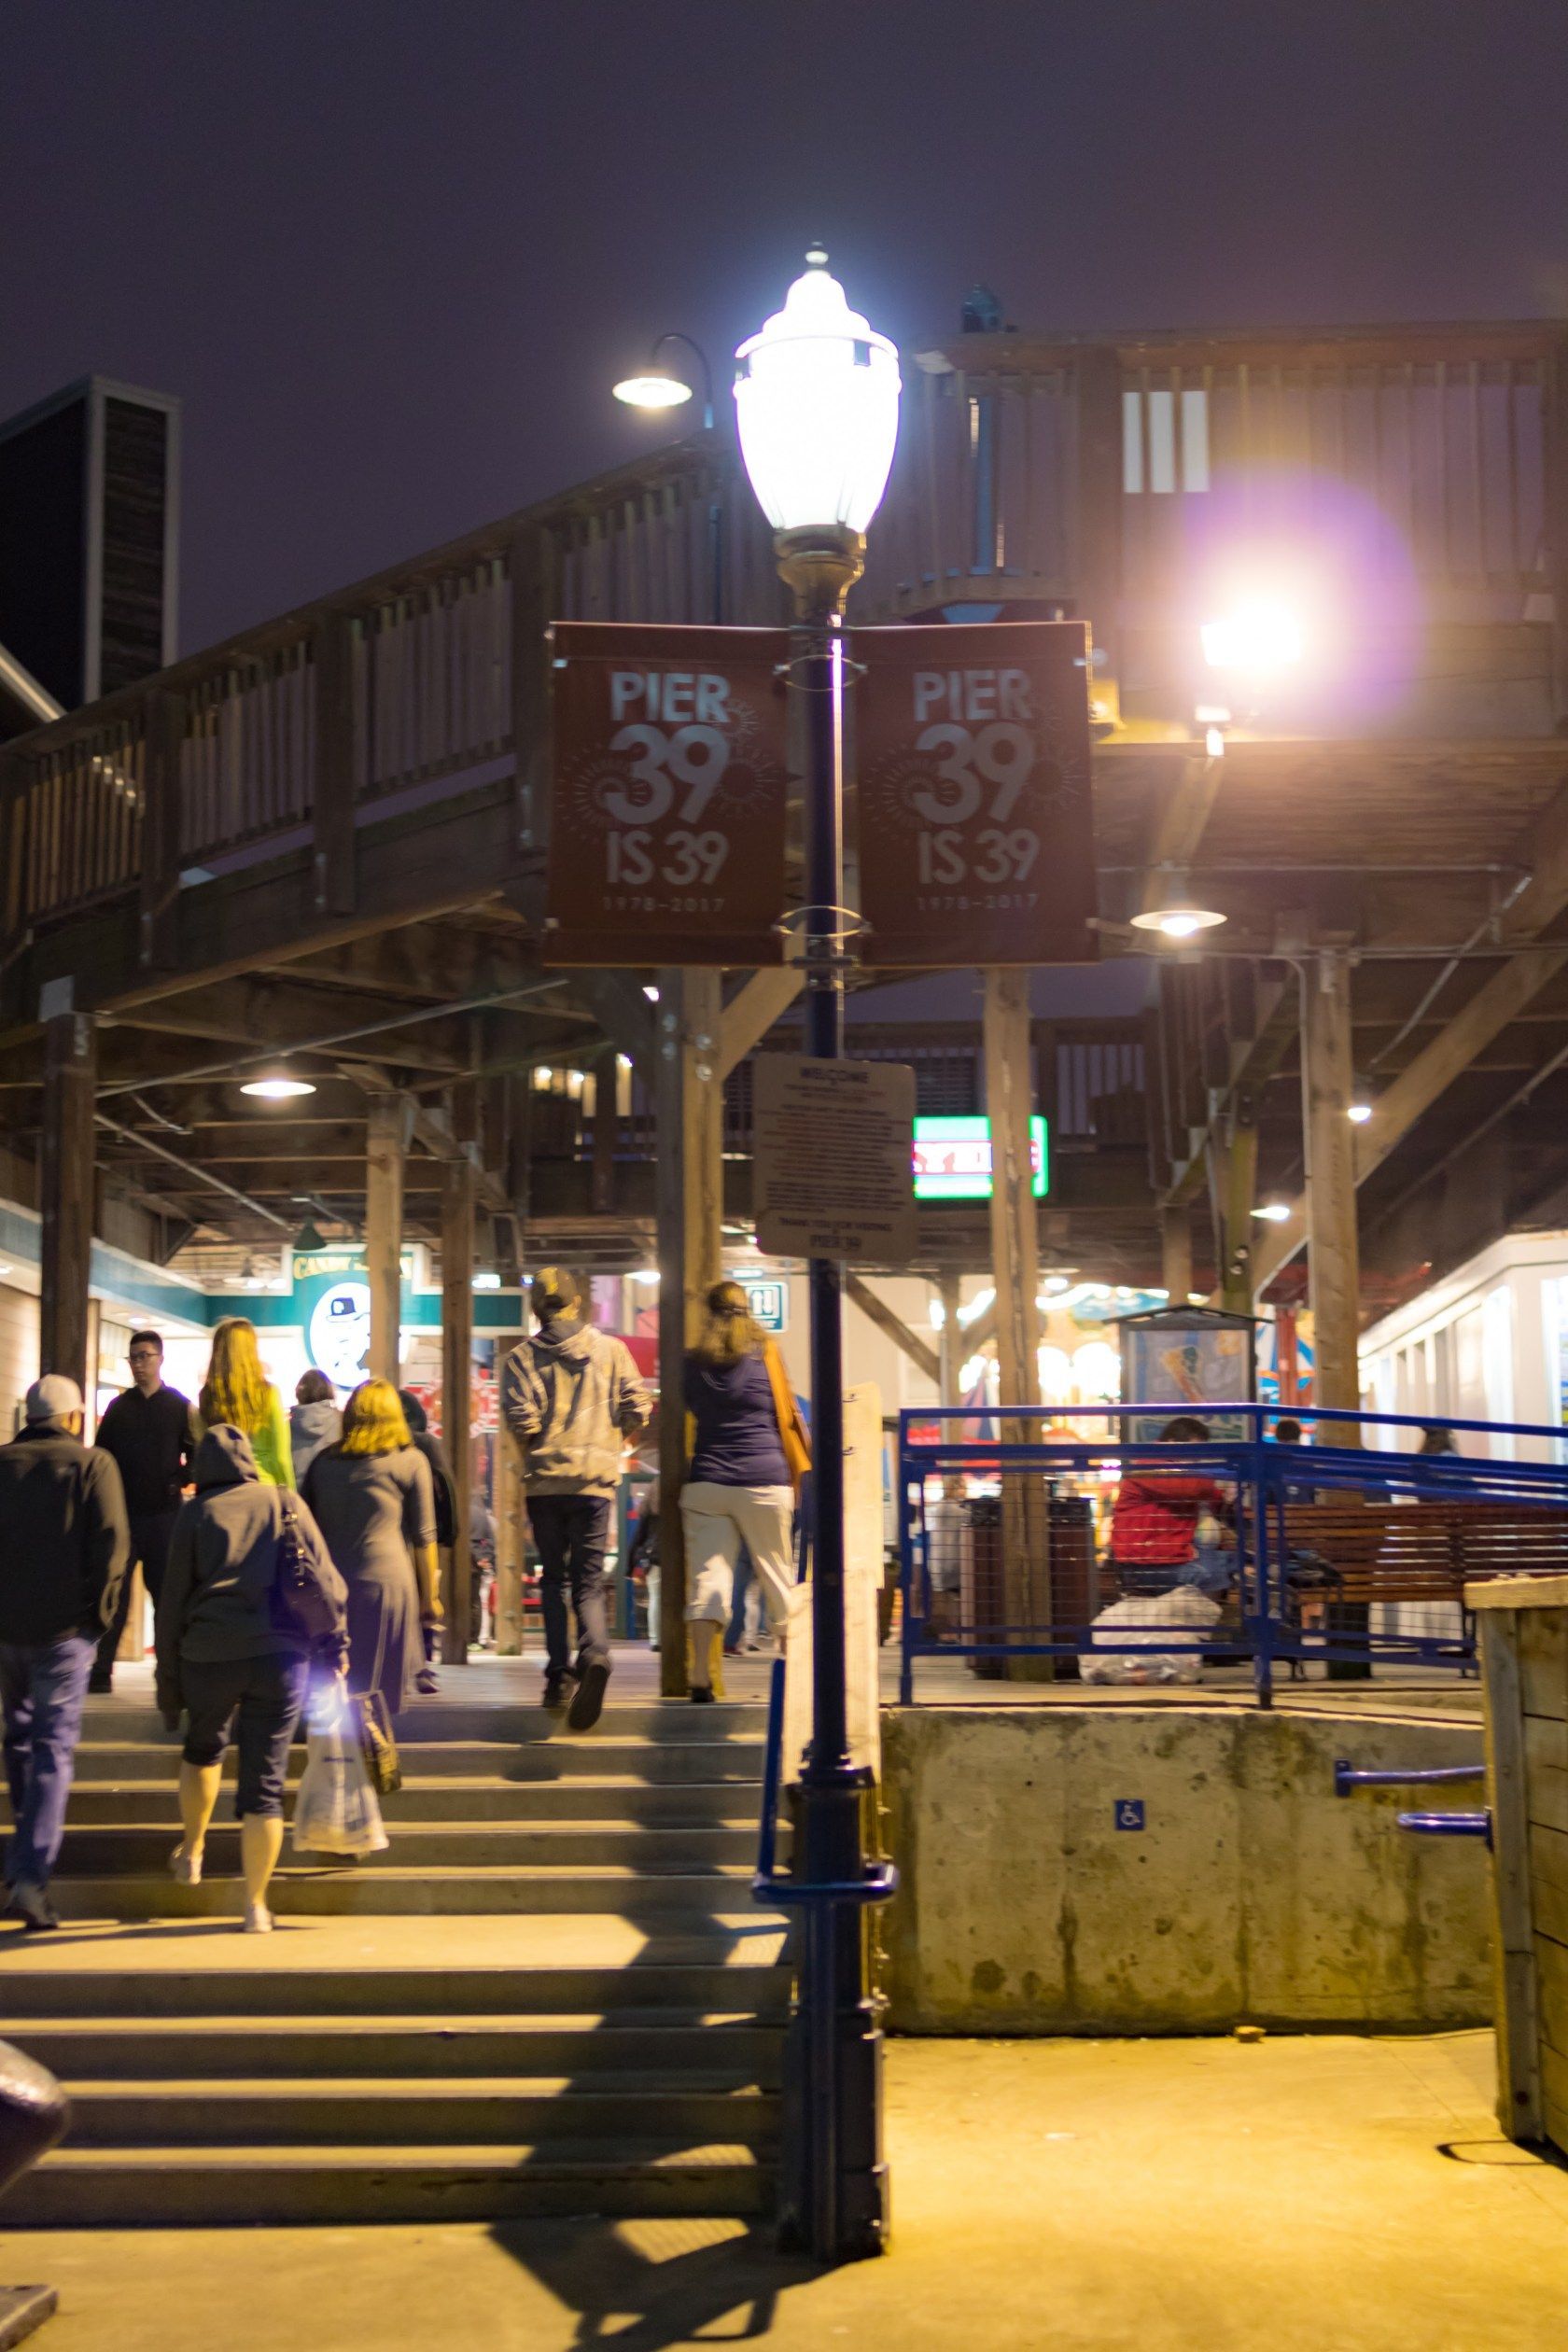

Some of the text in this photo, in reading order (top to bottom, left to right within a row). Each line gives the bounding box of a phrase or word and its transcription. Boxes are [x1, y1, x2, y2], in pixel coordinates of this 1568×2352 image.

[609, 671, 731, 723] PIER
[912, 668, 1032, 722] PIER
[605, 723, 730, 825] 39
[913, 721, 1035, 824] 39
[606, 830, 729, 886] IS 39
[917, 828, 1041, 885] IS 39
[602, 895, 725, 912] 1978-2017
